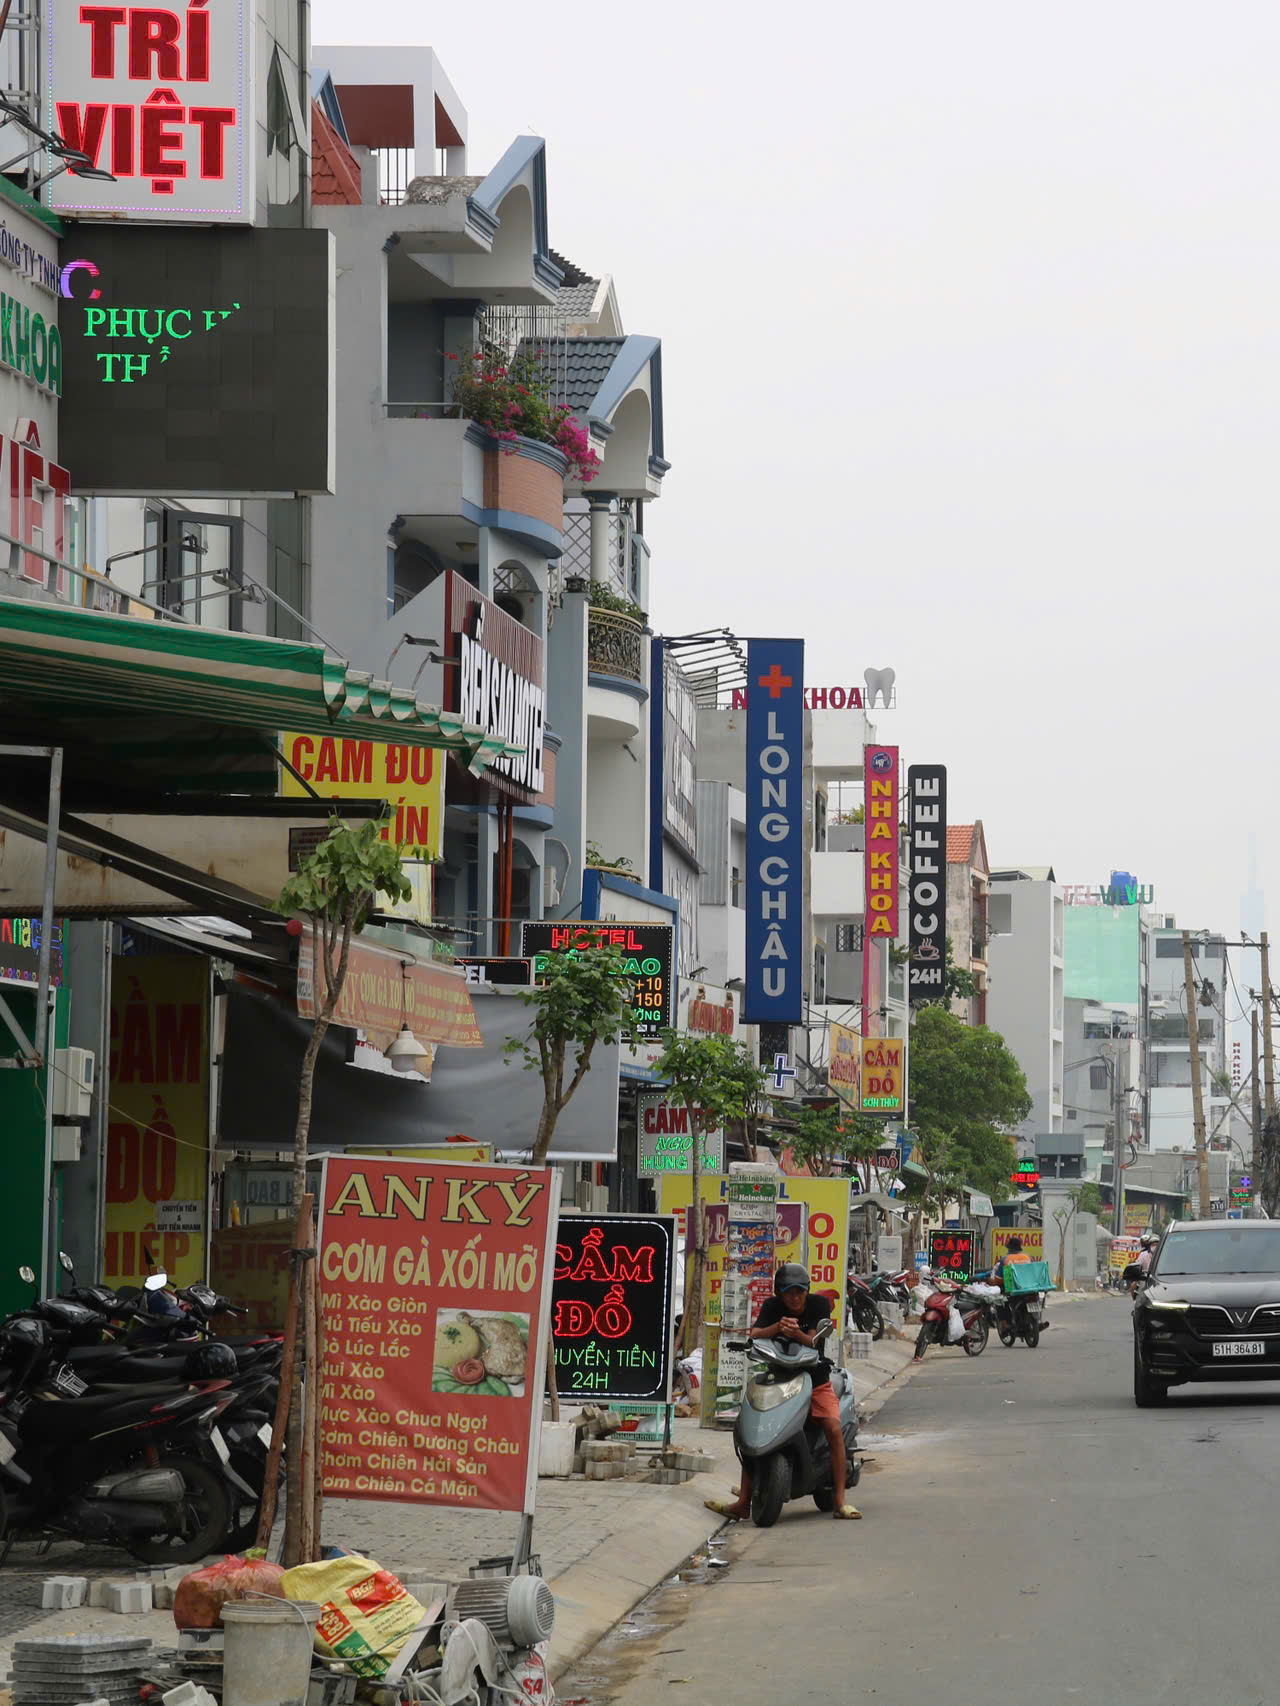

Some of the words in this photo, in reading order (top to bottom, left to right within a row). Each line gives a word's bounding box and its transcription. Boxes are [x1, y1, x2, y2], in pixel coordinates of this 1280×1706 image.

[80, 0, 210, 82] TRÍ
[56, 88, 236, 195] VIỆT
[23, 243, 36, 277] TY
[84, 306, 192, 344] PHỤC
[0, 291, 62, 397] KHOA
[803, 687, 863, 709] KHOA
[758, 711, 790, 842] LONG
[870, 779, 893, 840] NHA
[915, 777, 939, 935] COFFEE
[870, 851, 893, 933] KHOA
[758, 855, 789, 998] CHÂU
[910, 968, 942, 984] 24H
[739, 1174, 774, 1182] Heineken
[327, 1172, 434, 1222] AN
[440, 1171, 545, 1227] KÝ
[739, 1194, 773, 1202] Heineken
[742, 1227, 765, 1240] Tiger
[995, 1231, 1043, 1247] MASAGE
[742, 1242, 762, 1255] Tiger
[322, 1238, 387, 1283] CƠM
[393, 1235, 431, 1287] GÀ
[438, 1232, 487, 1290] XỐI
[493, 1244, 538, 1293] MỠ
[346, 1294, 382, 1311] Xào
[387, 1297, 427, 1314] Giòn
[348, 1315, 382, 1334] Tiếu
[386, 1318, 422, 1336] Xào
[345, 1338, 375, 1356] Lúc
[380, 1337, 411, 1358] Lắc
[617, 1344, 656, 1368] TIỀN
[350, 1361, 384, 1379] Xào
[572, 1371, 609, 1389] 24H
[340, 1383, 376, 1401] Xào
[355, 1407, 390, 1424] Xào
[395, 1410, 442, 1428] Chua
[447, 1413, 488, 1434] Ngọt
[358, 1430, 409, 1448] Chiên
[413, 1433, 469, 1456] Dương
[473, 1437, 520, 1455] Châu
[367, 1453, 417, 1471] Chiên
[423, 1454, 451, 1473] Hải
[456, 1457, 488, 1475] Sản
[322, 1475, 350, 1489] ơm
[355, 1475, 405, 1493] Chiên
[410, 1478, 435, 1495] Cá
[441, 1479, 478, 1500] Mặn
